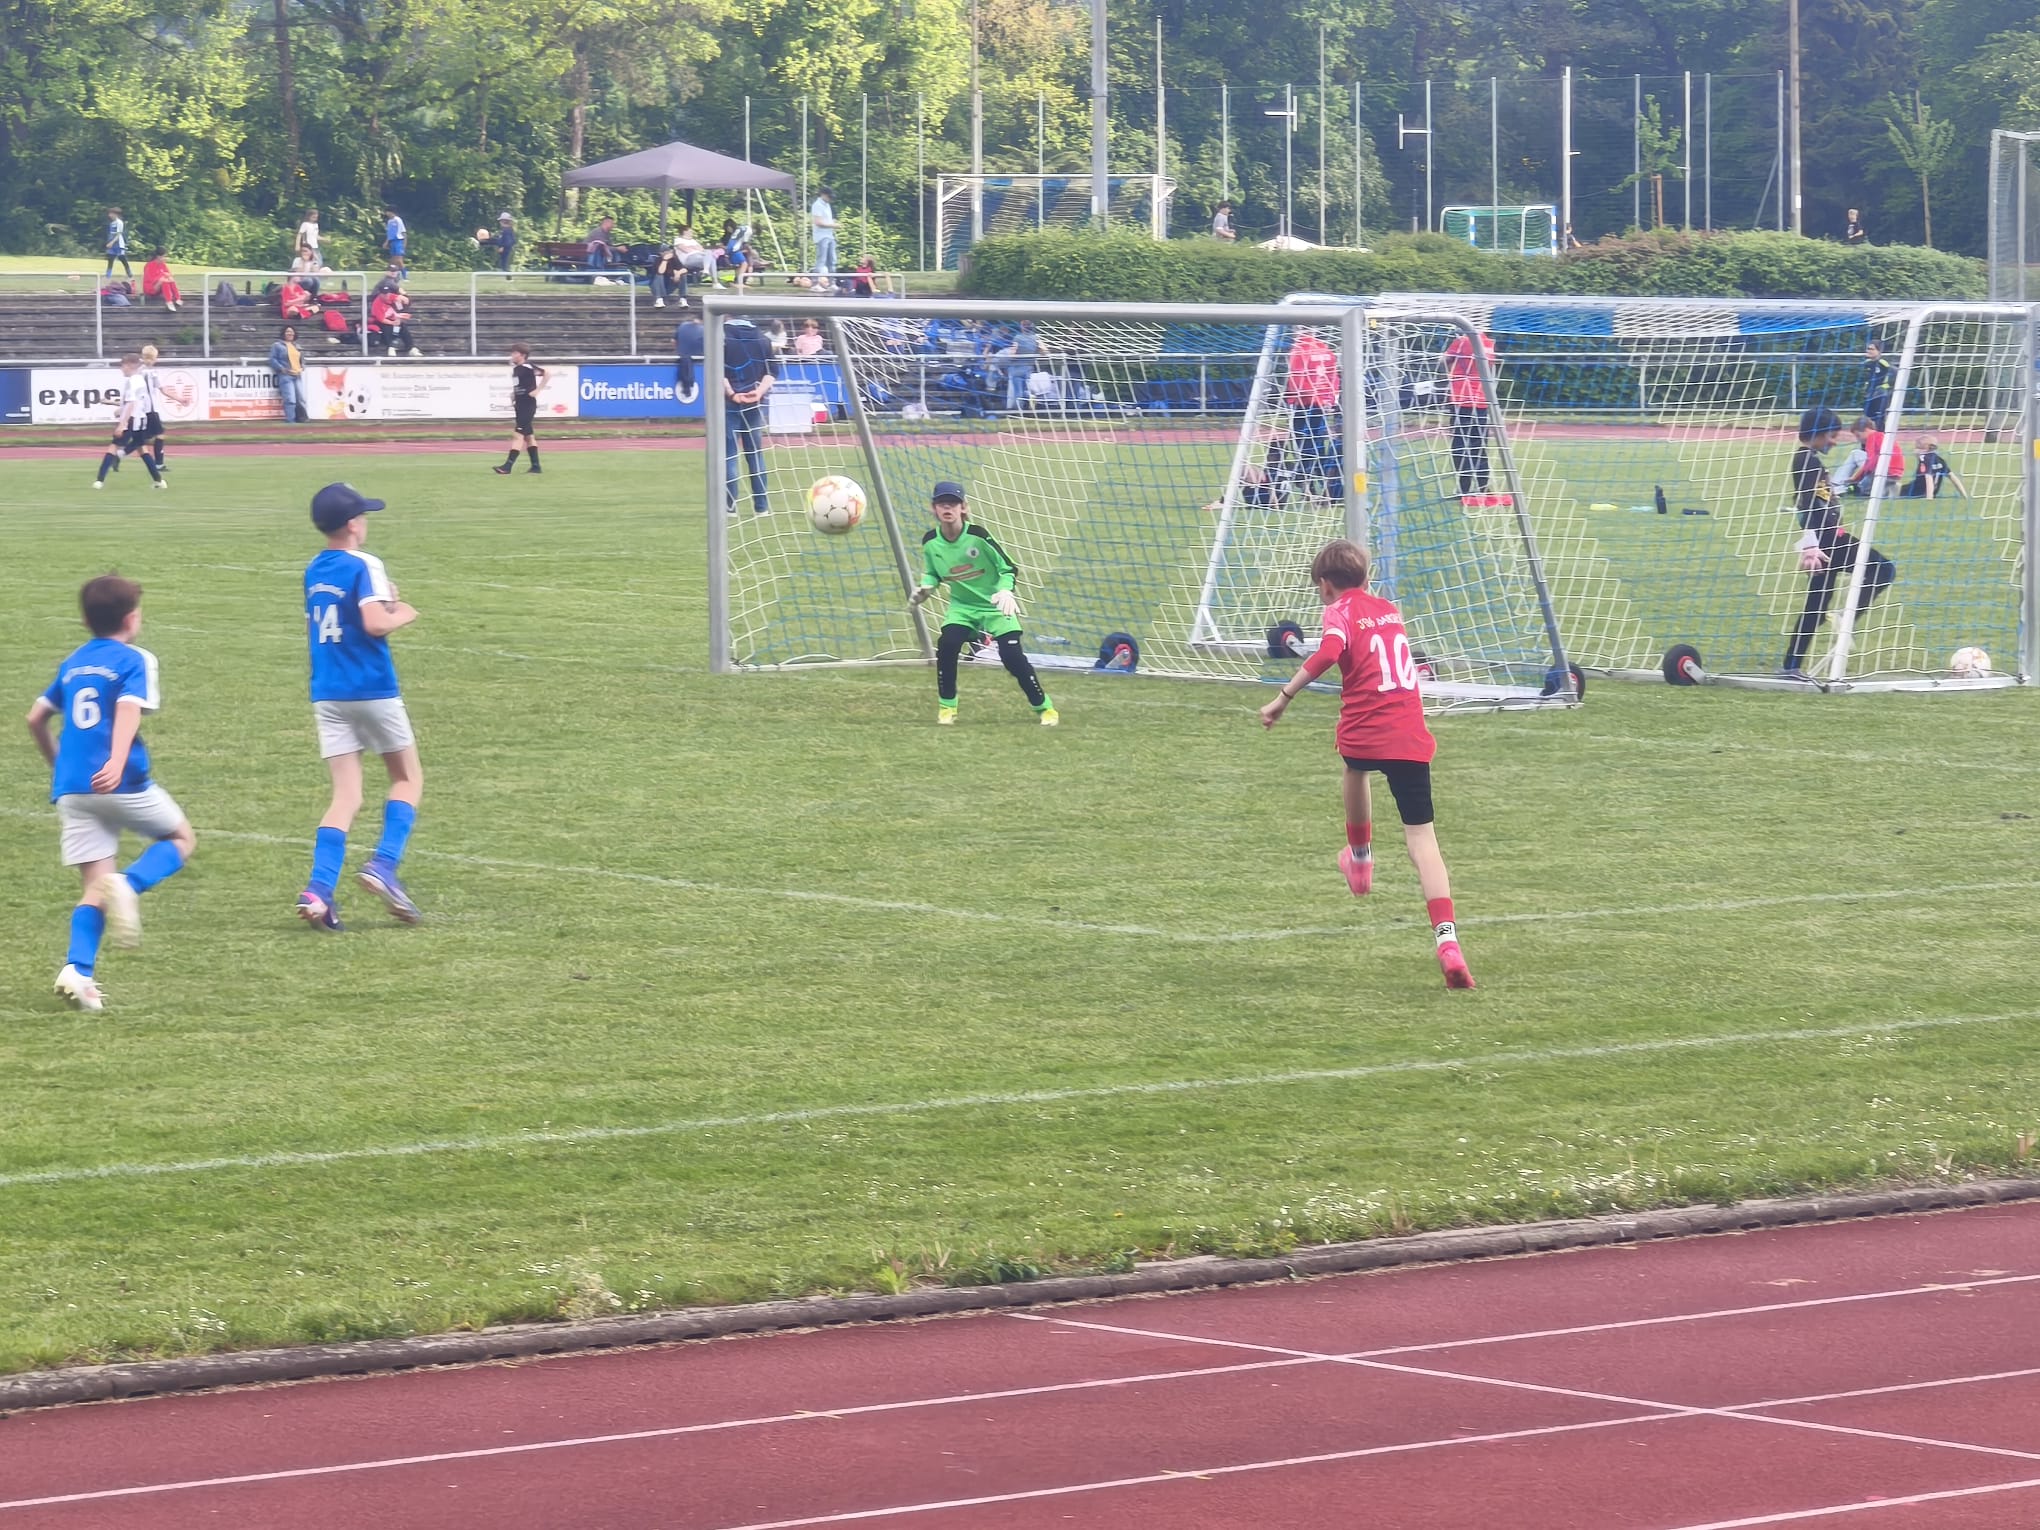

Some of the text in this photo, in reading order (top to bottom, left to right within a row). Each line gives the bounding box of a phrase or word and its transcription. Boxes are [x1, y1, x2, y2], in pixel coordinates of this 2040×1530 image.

[580, 378, 674, 400] Öffentliche
[1370, 633, 1417, 692] 10
[72, 687, 101, 730] 6
